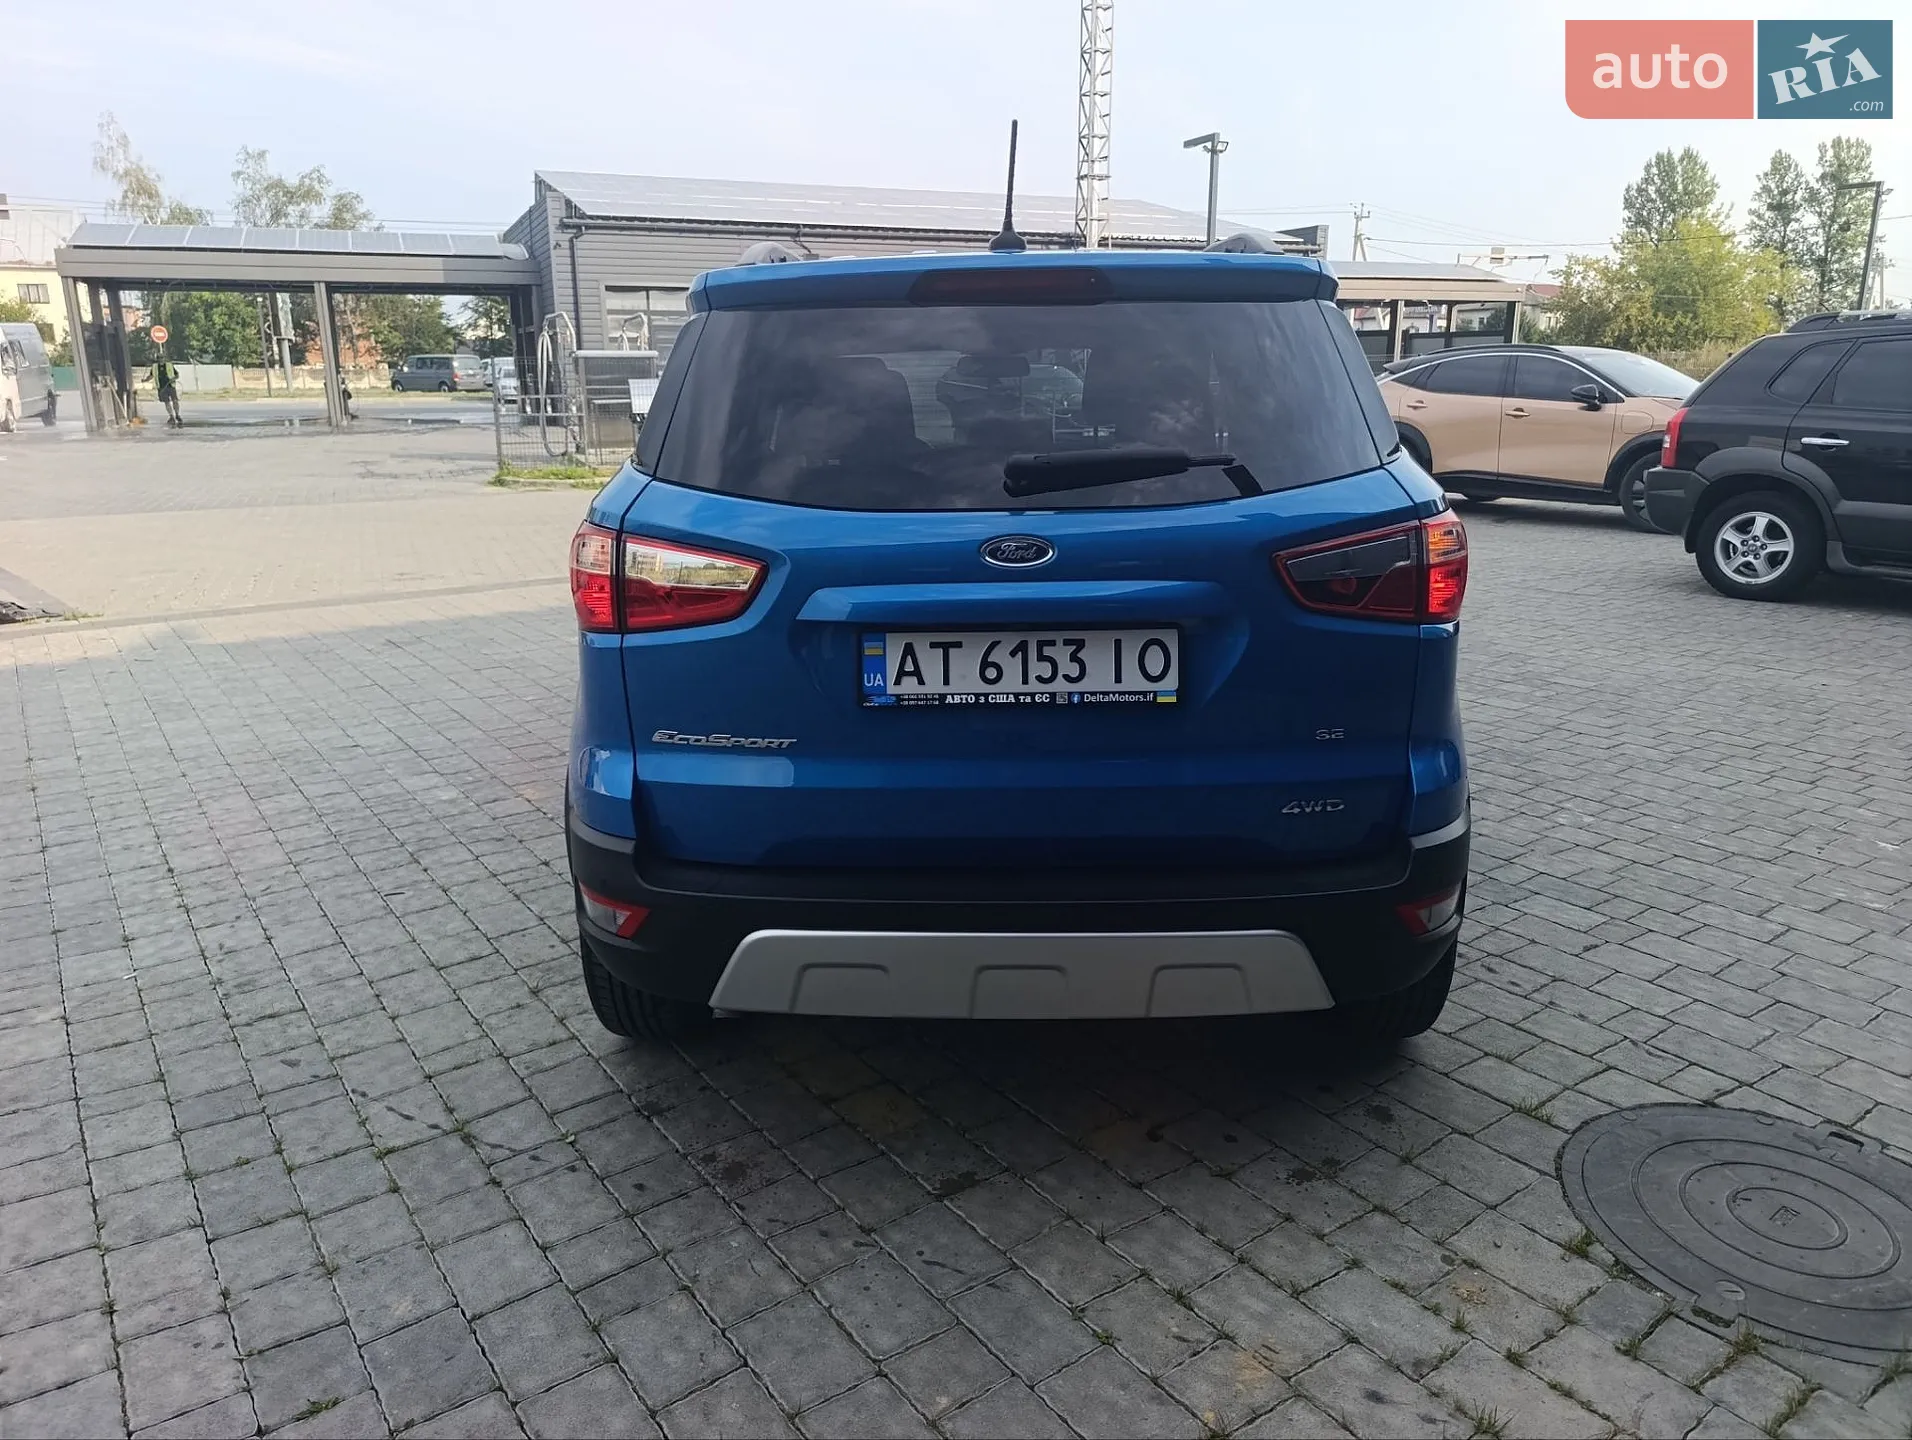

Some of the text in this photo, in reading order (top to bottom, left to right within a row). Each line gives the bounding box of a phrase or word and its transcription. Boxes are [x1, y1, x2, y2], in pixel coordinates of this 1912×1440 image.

[997, 543, 1037, 559] Ford
[892, 641, 963, 686] AT
[978, 639, 1087, 686] 6153
[864, 673, 884, 687] UA
[945, 694, 975, 704] АВТО
[988, 694, 1016, 703] США
[1019, 695, 1032, 703] та
[1084, 692, 1154, 703] DeltaMotors.if
[1315, 728, 1345, 740] SE
[1281, 799, 1345, 813] 4WD
